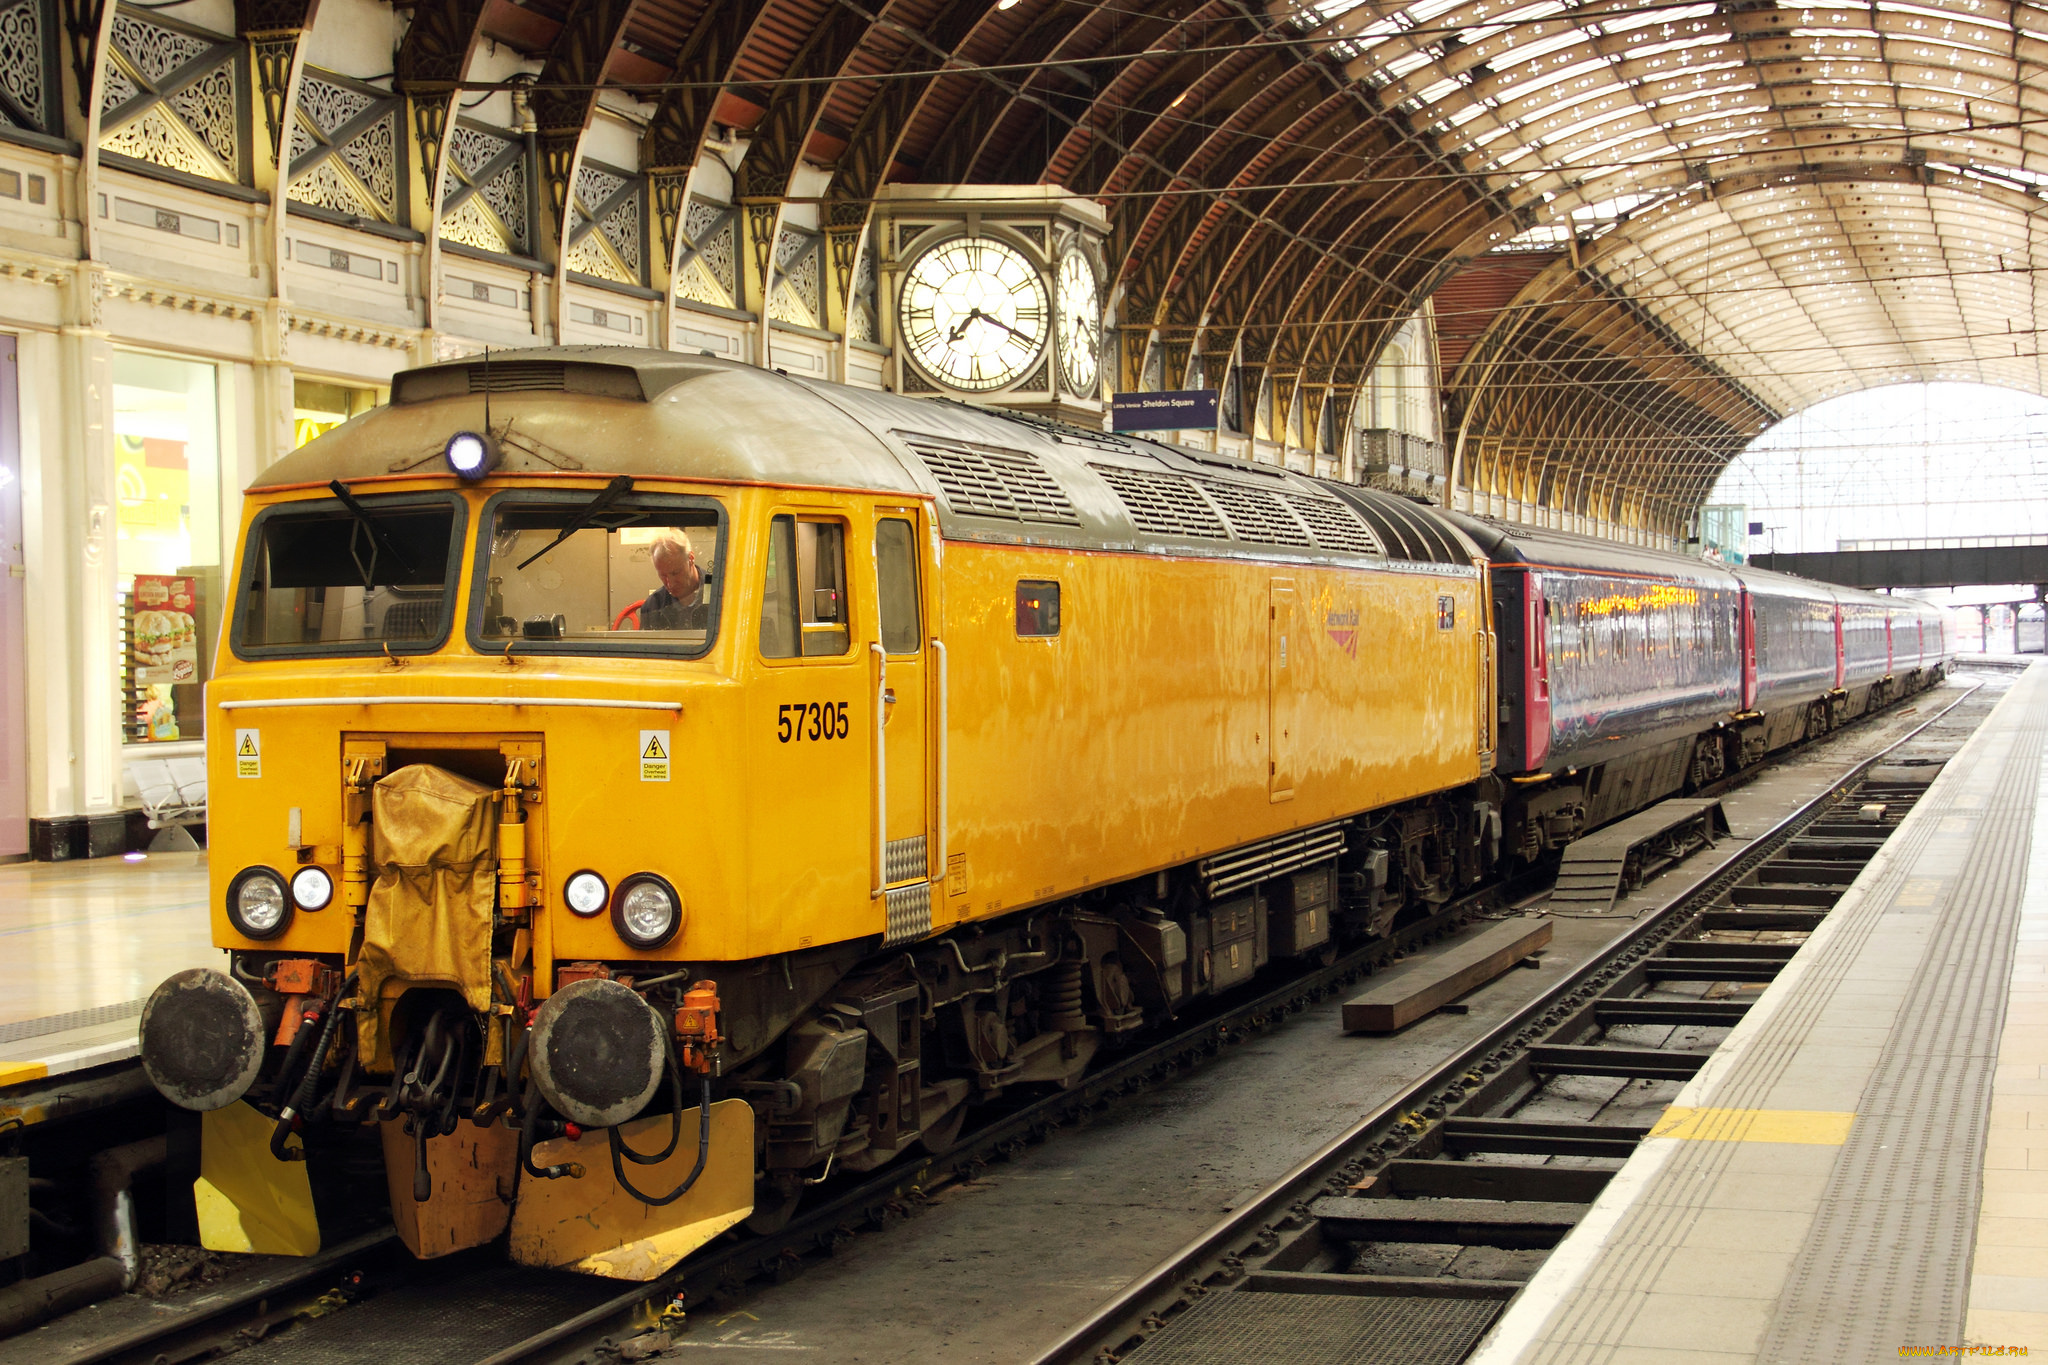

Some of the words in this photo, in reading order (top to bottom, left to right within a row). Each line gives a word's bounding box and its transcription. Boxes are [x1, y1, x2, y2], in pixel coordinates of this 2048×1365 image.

[1142, 399, 1170, 408] Sheldon
[1171, 398, 1195, 408] Square
[777, 701, 849, 743] 57305
